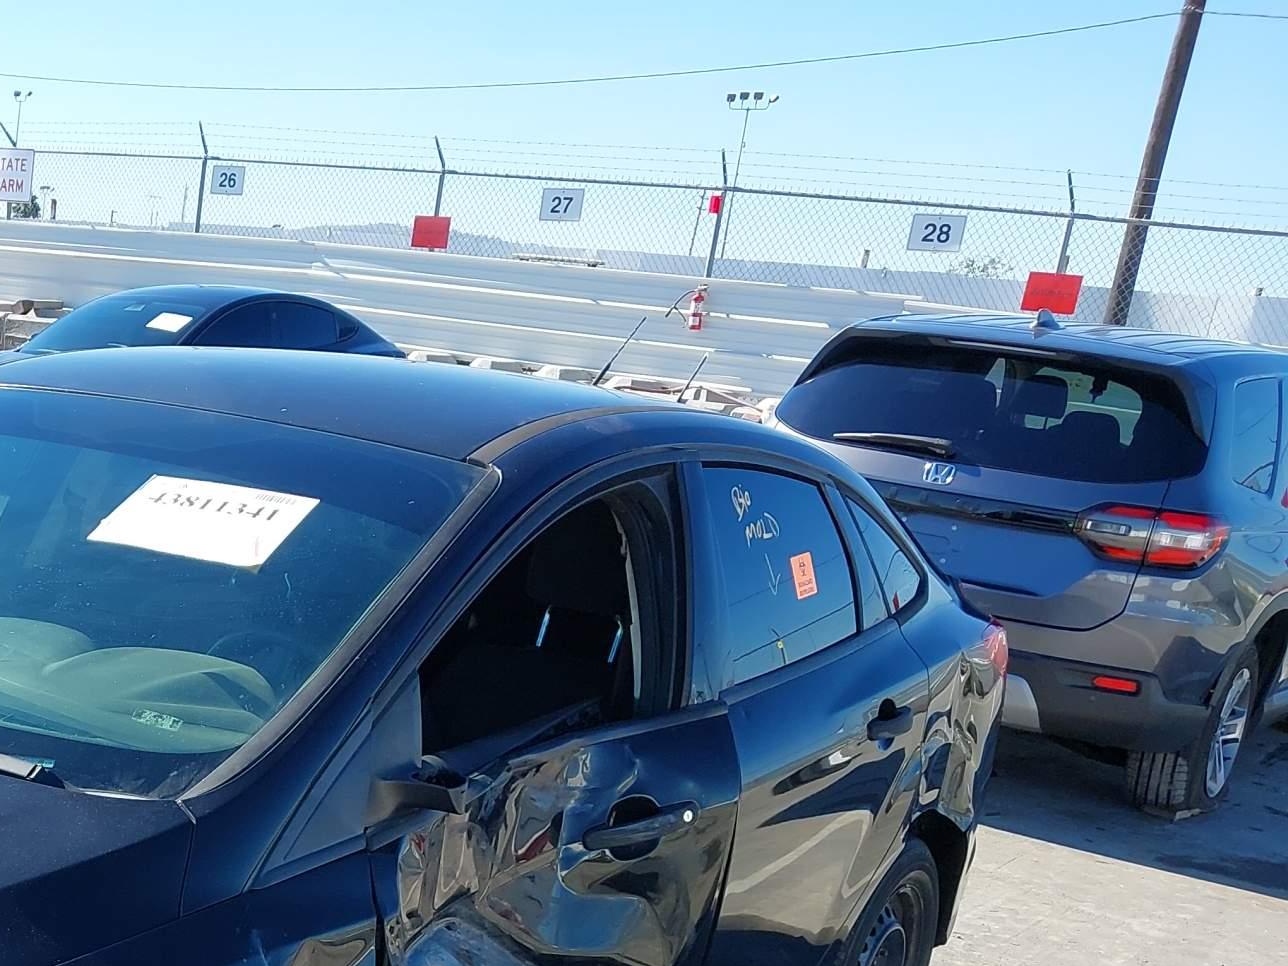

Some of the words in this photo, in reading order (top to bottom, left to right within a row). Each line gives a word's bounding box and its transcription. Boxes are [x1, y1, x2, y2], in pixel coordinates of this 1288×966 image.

[218, 172, 237, 188] 26
[550, 196, 574, 214] 27
[921, 222, 952, 244] 28
[148, 492, 280, 521] 43811341
